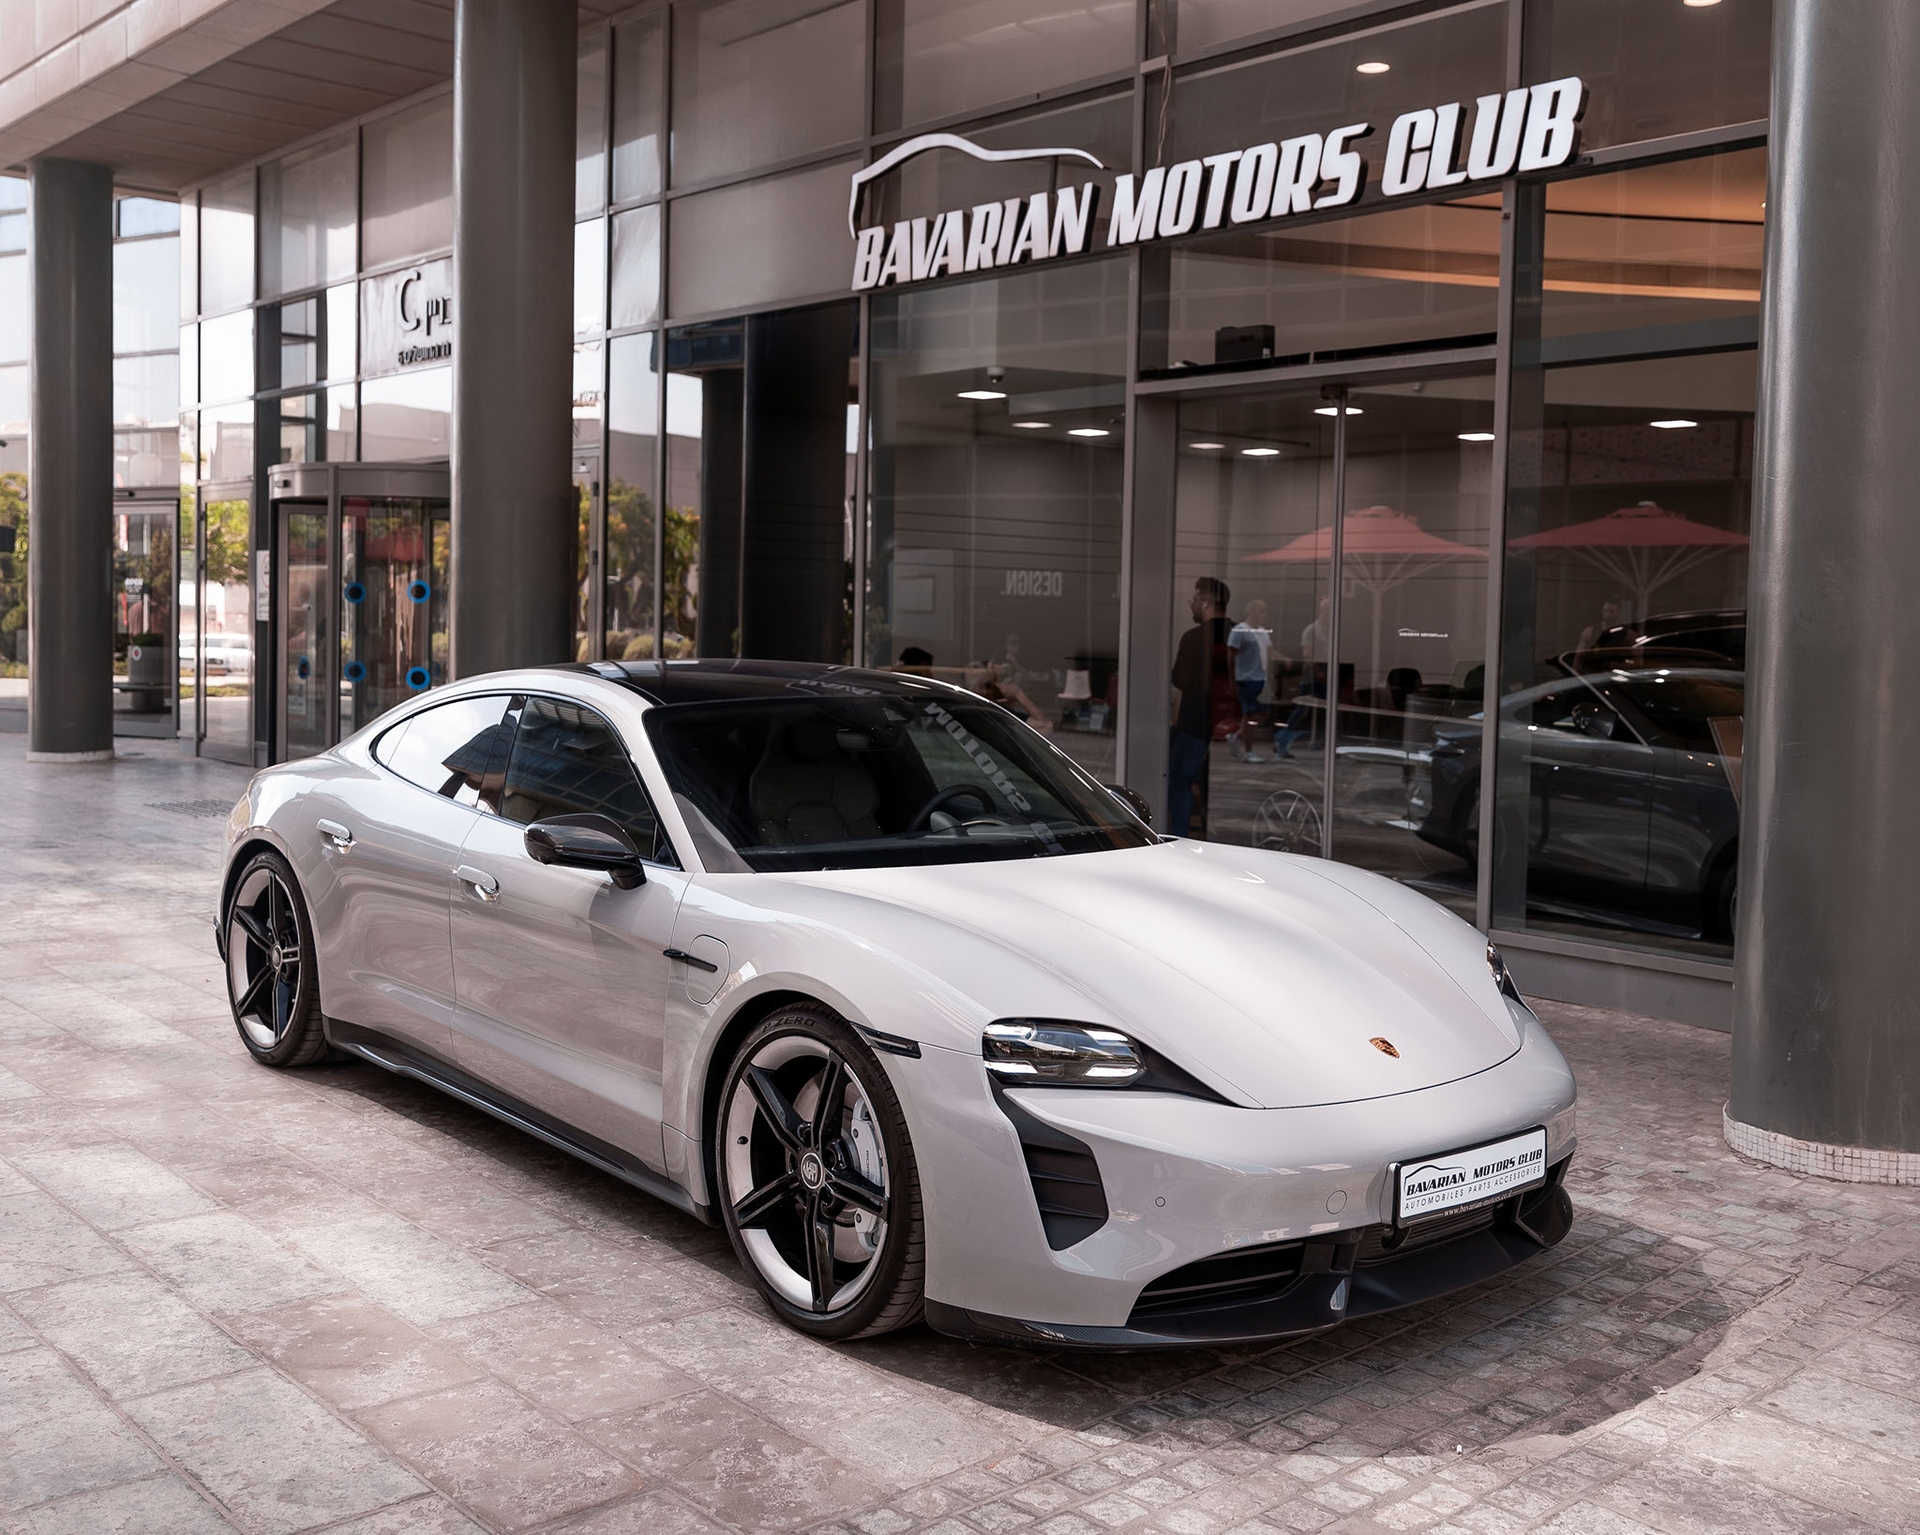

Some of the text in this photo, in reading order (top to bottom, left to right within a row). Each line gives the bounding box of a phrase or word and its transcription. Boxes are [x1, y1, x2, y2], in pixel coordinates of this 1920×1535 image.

[851, 77, 1583, 291] BAVARIAN MOTORS CLUB
[774, 1016, 816, 1028] ZERO
[1404, 1165, 1541, 1211] AUTOMOBILES PARTS ACCESSORIES
[1407, 1149, 1543, 1196] BAVARIAN MOTORS CLUB
